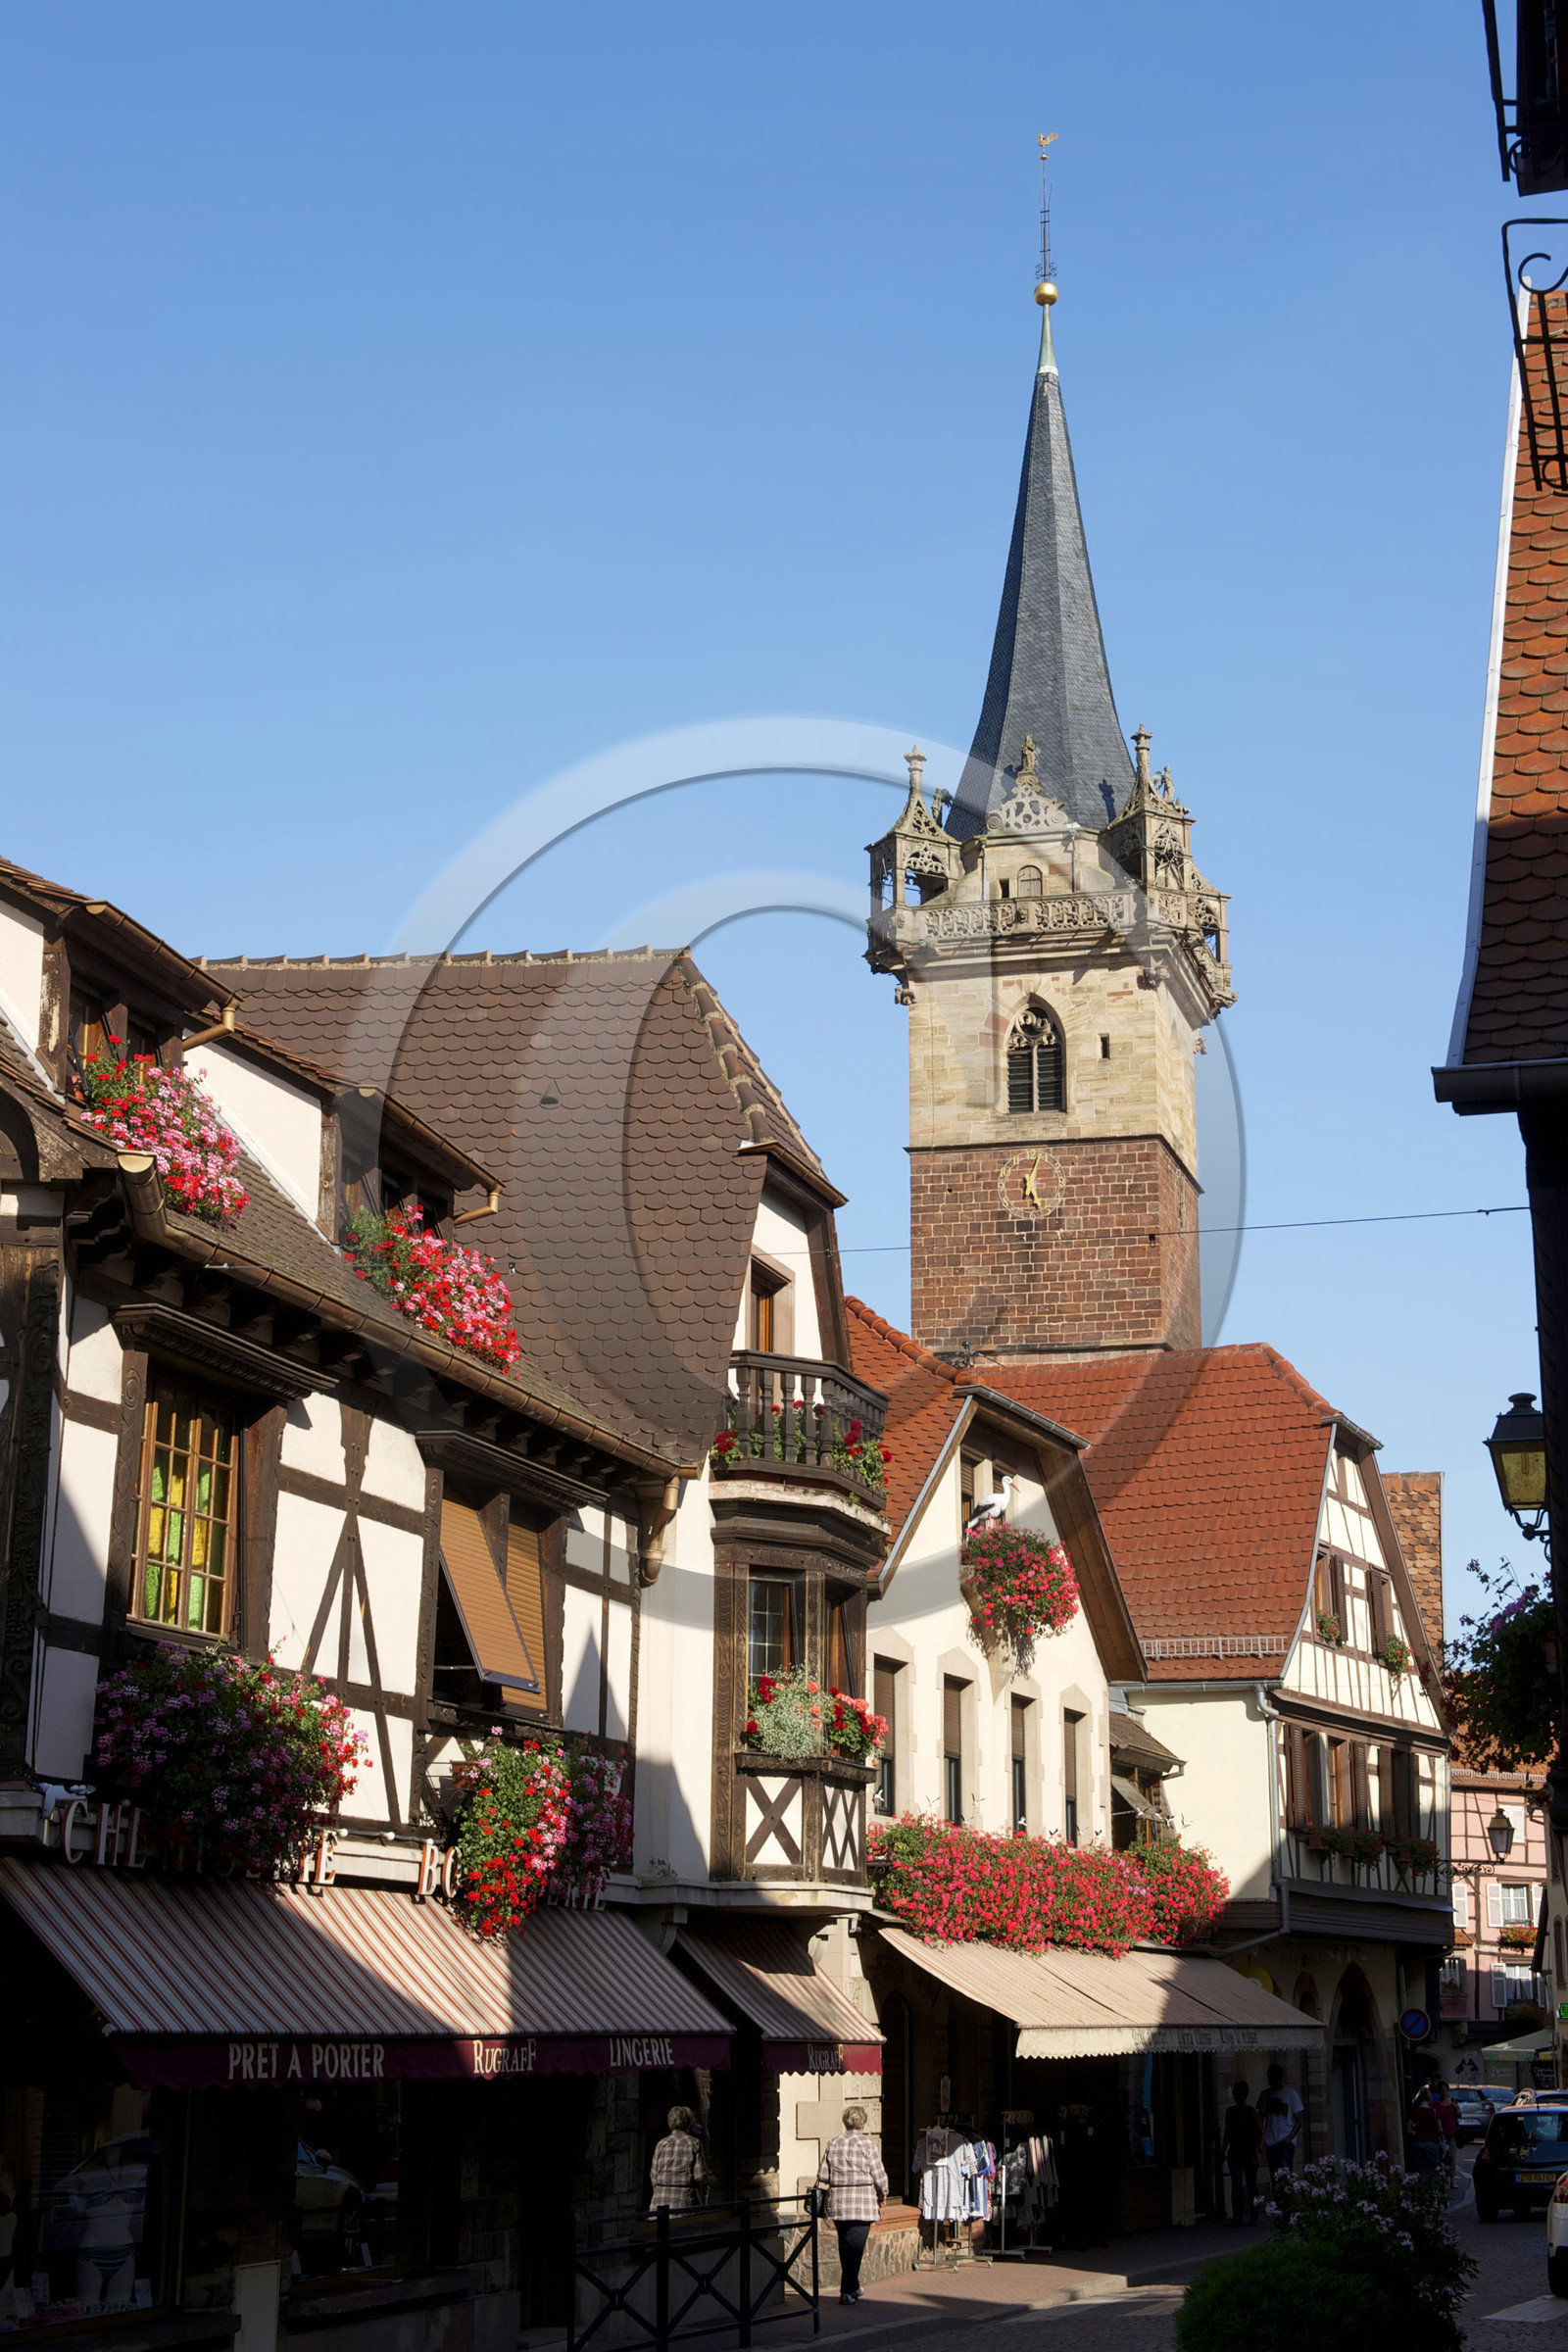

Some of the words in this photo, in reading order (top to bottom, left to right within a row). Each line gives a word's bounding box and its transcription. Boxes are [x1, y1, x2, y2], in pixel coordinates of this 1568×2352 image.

[1012, 1154, 1020, 1165] 11
[1026, 1149, 1036, 1160] 12
[1001, 1166, 1011, 1177] 10
[228, 2042, 279, 2080] PRET
[287, 2042, 302, 2079] A
[312, 2042, 384, 2079] PORTER
[472, 2038, 537, 2074] RUGRAFF
[609, 2037, 674, 2067] LINGERIE
